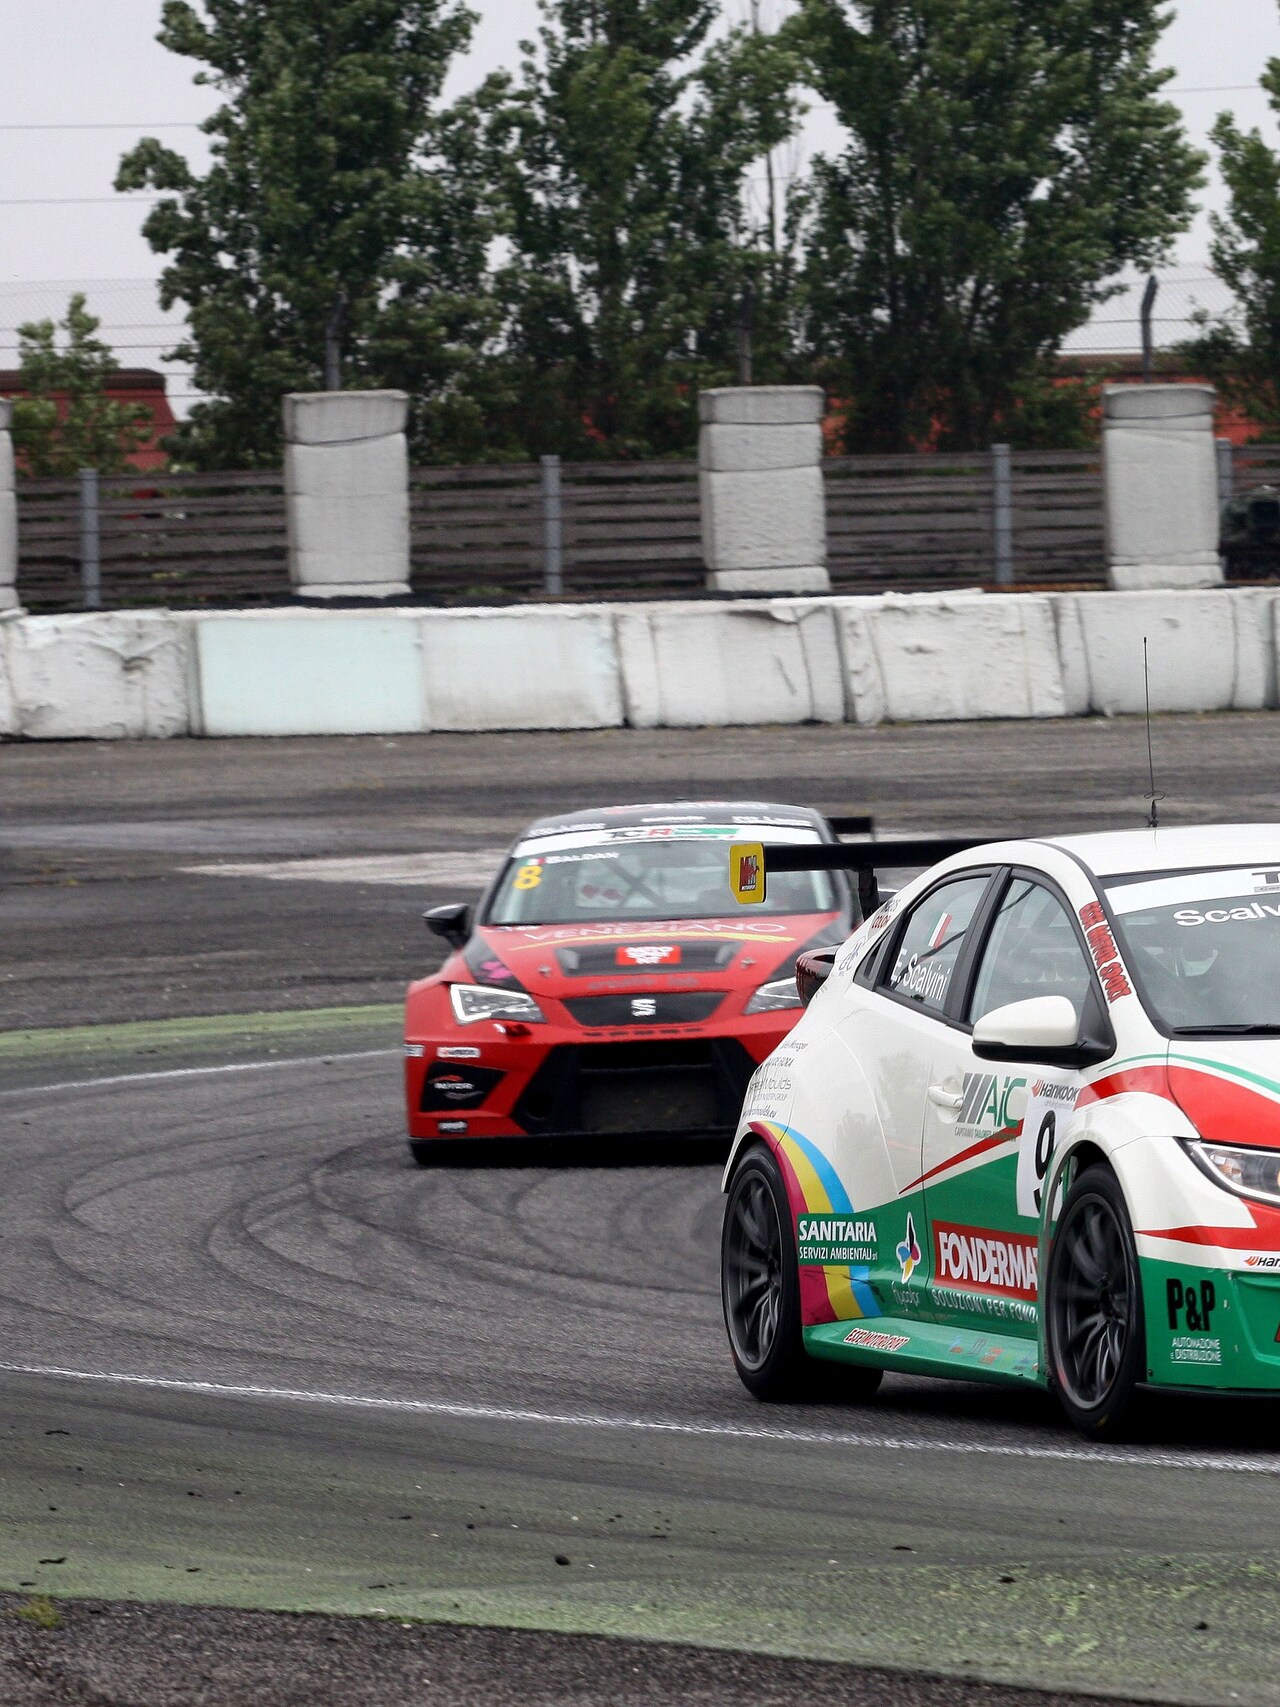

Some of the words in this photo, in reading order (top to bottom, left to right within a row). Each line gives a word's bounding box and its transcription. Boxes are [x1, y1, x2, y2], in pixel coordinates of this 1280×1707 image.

[513, 865, 543, 890] 8
[903, 952, 952, 1002] Scalvini
[1033, 1109, 1056, 1214] 9
[799, 1220, 877, 1242] SANITARIA
[799, 1246, 828, 1260] SERVIZI
[830, 1247, 873, 1260] AMBIENTALI
[931, 1288, 985, 1313] SOLUZIONI
[986, 1299, 1006, 1317] PER
[1010, 1304, 1039, 1324] FOND
[1166, 1278, 1215, 1332] P&P
